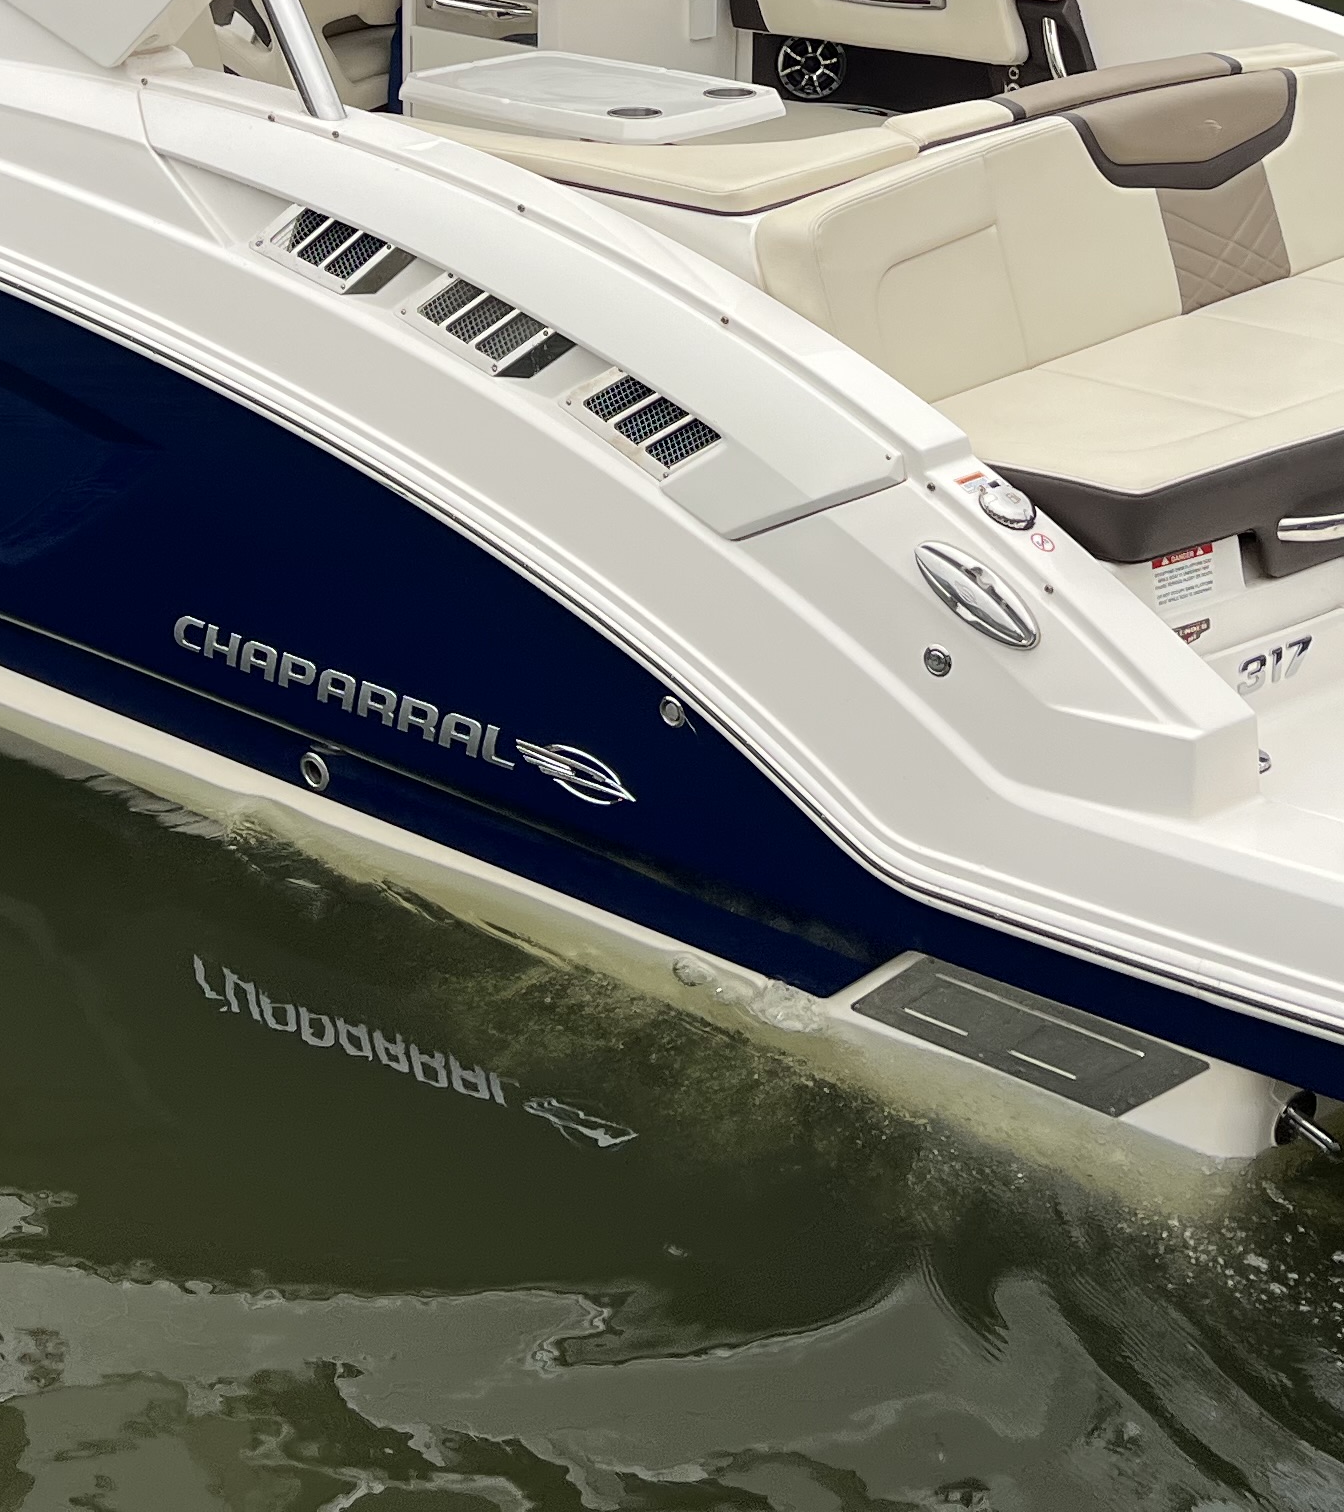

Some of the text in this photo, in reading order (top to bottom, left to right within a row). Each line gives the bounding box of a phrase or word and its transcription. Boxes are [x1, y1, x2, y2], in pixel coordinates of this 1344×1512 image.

[1170, 550, 1195, 563] DANGER
[173, 615, 516, 771] CHAPARRAL
[1236, 635, 1314, 696] 317
